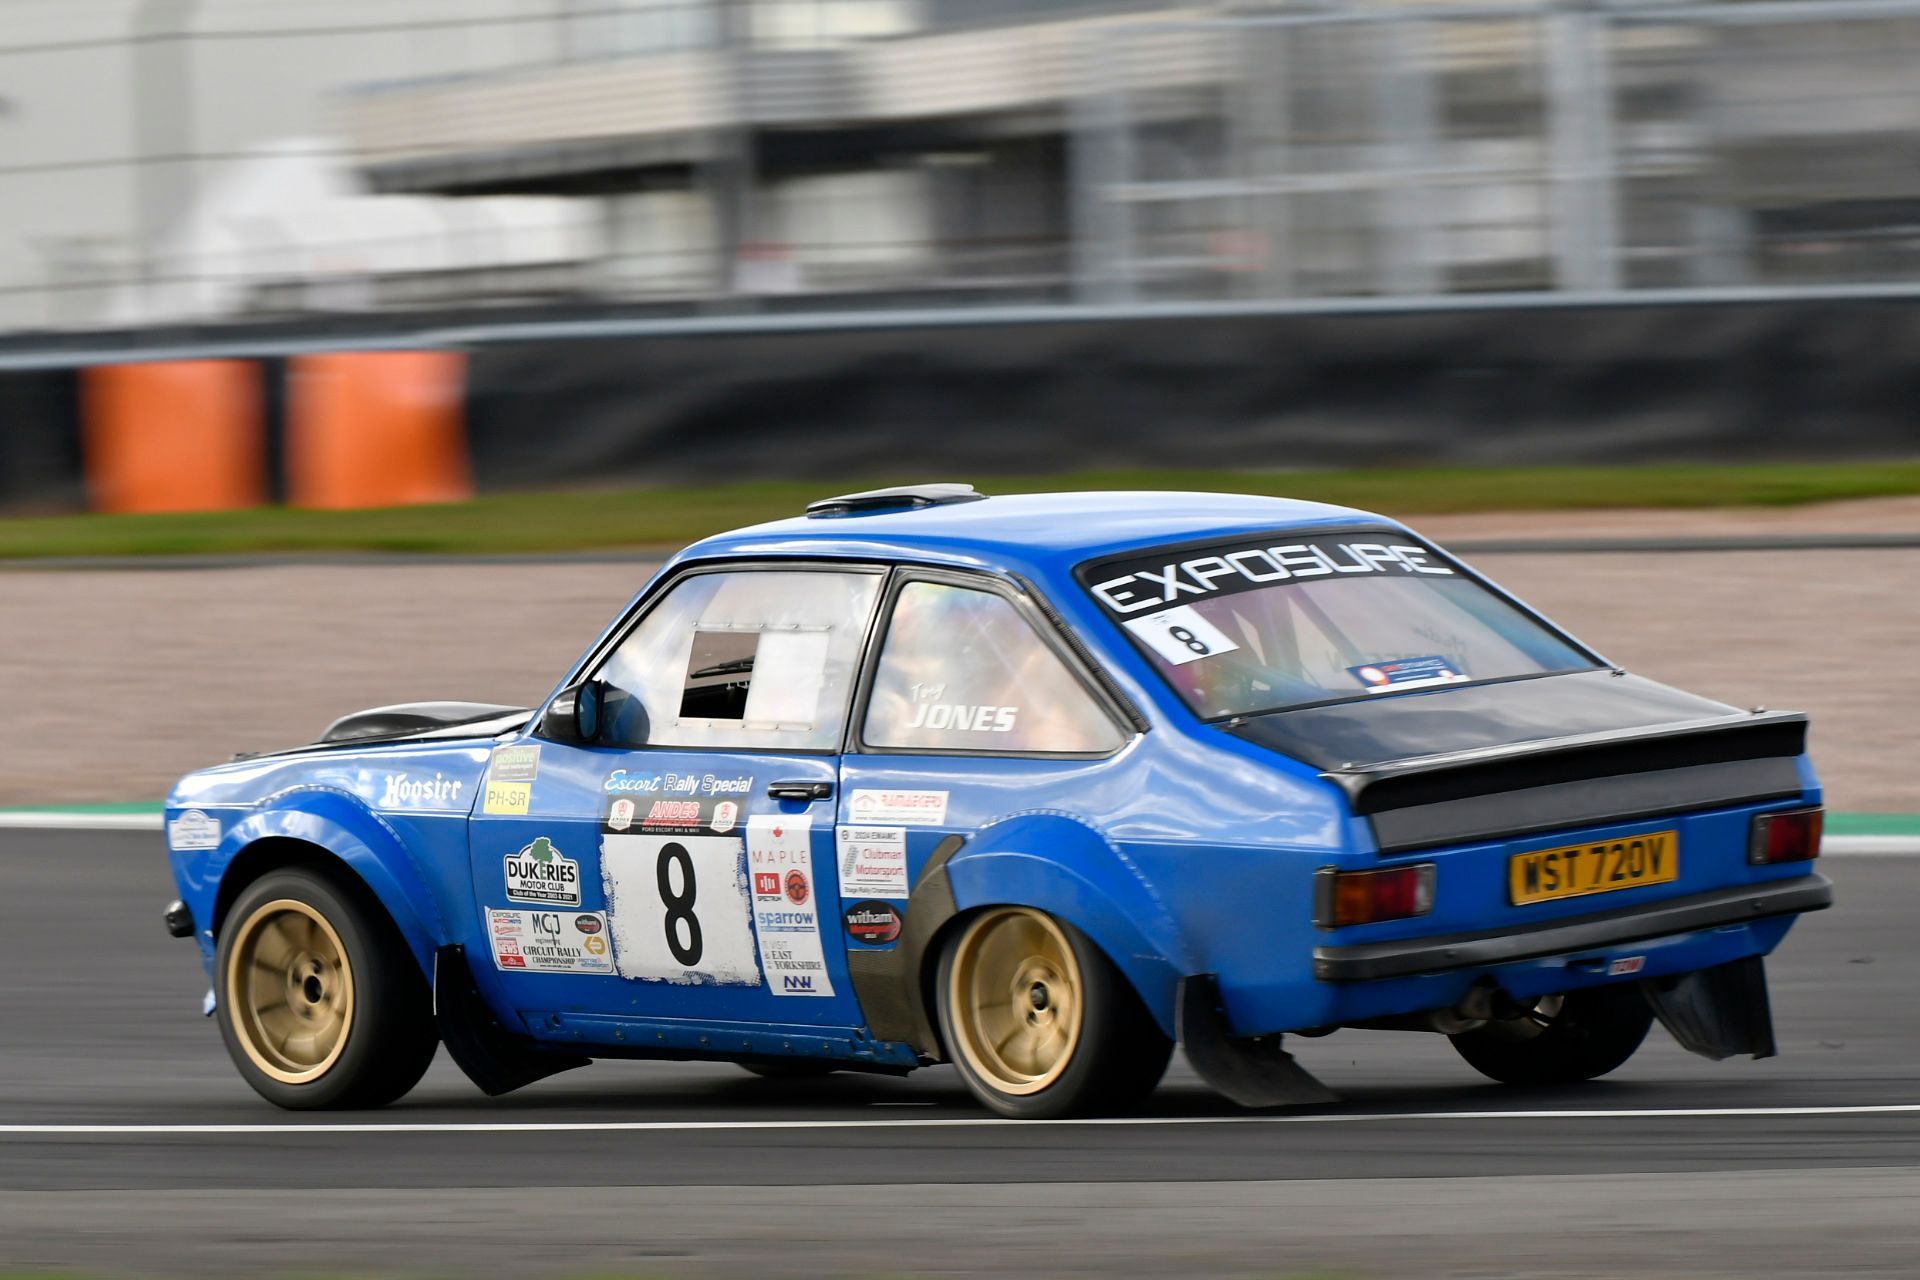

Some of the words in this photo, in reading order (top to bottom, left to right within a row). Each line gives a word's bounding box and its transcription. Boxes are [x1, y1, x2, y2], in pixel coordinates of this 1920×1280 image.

[1090, 543, 1454, 613] EXPOSURE
[1169, 625, 1210, 655] 8
[906, 703, 1019, 732] JONES
[379, 772, 462, 807] Hoosier
[604, 769, 662, 792] Escort
[663, 773, 701, 796] Rally
[702, 774, 754, 796] Special
[488, 790, 526, 807] PH-SR
[648, 800, 701, 819] ANDES
[752, 850, 807, 864] MAPLE
[863, 848, 903, 860] Clubman
[508, 860, 576, 883] DUKERIES
[856, 864, 905, 878] Motorsport
[1523, 850, 1580, 894] WST
[1589, 837, 1665, 885] 720V
[520, 880, 547, 890] MOTOR
[547, 882, 565, 891] CLUB
[656, 841, 703, 967] 8
[758, 912, 814, 927] sparrow
[847, 909, 893, 924] witham
[522, 945, 556, 957] CIRCUIT
[556, 947, 581, 957] RALLY
[771, 951, 793, 960] EAST
[532, 957, 576, 965] CHAMPIONSHIP
[774, 961, 824, 970] YORKSHIRE
